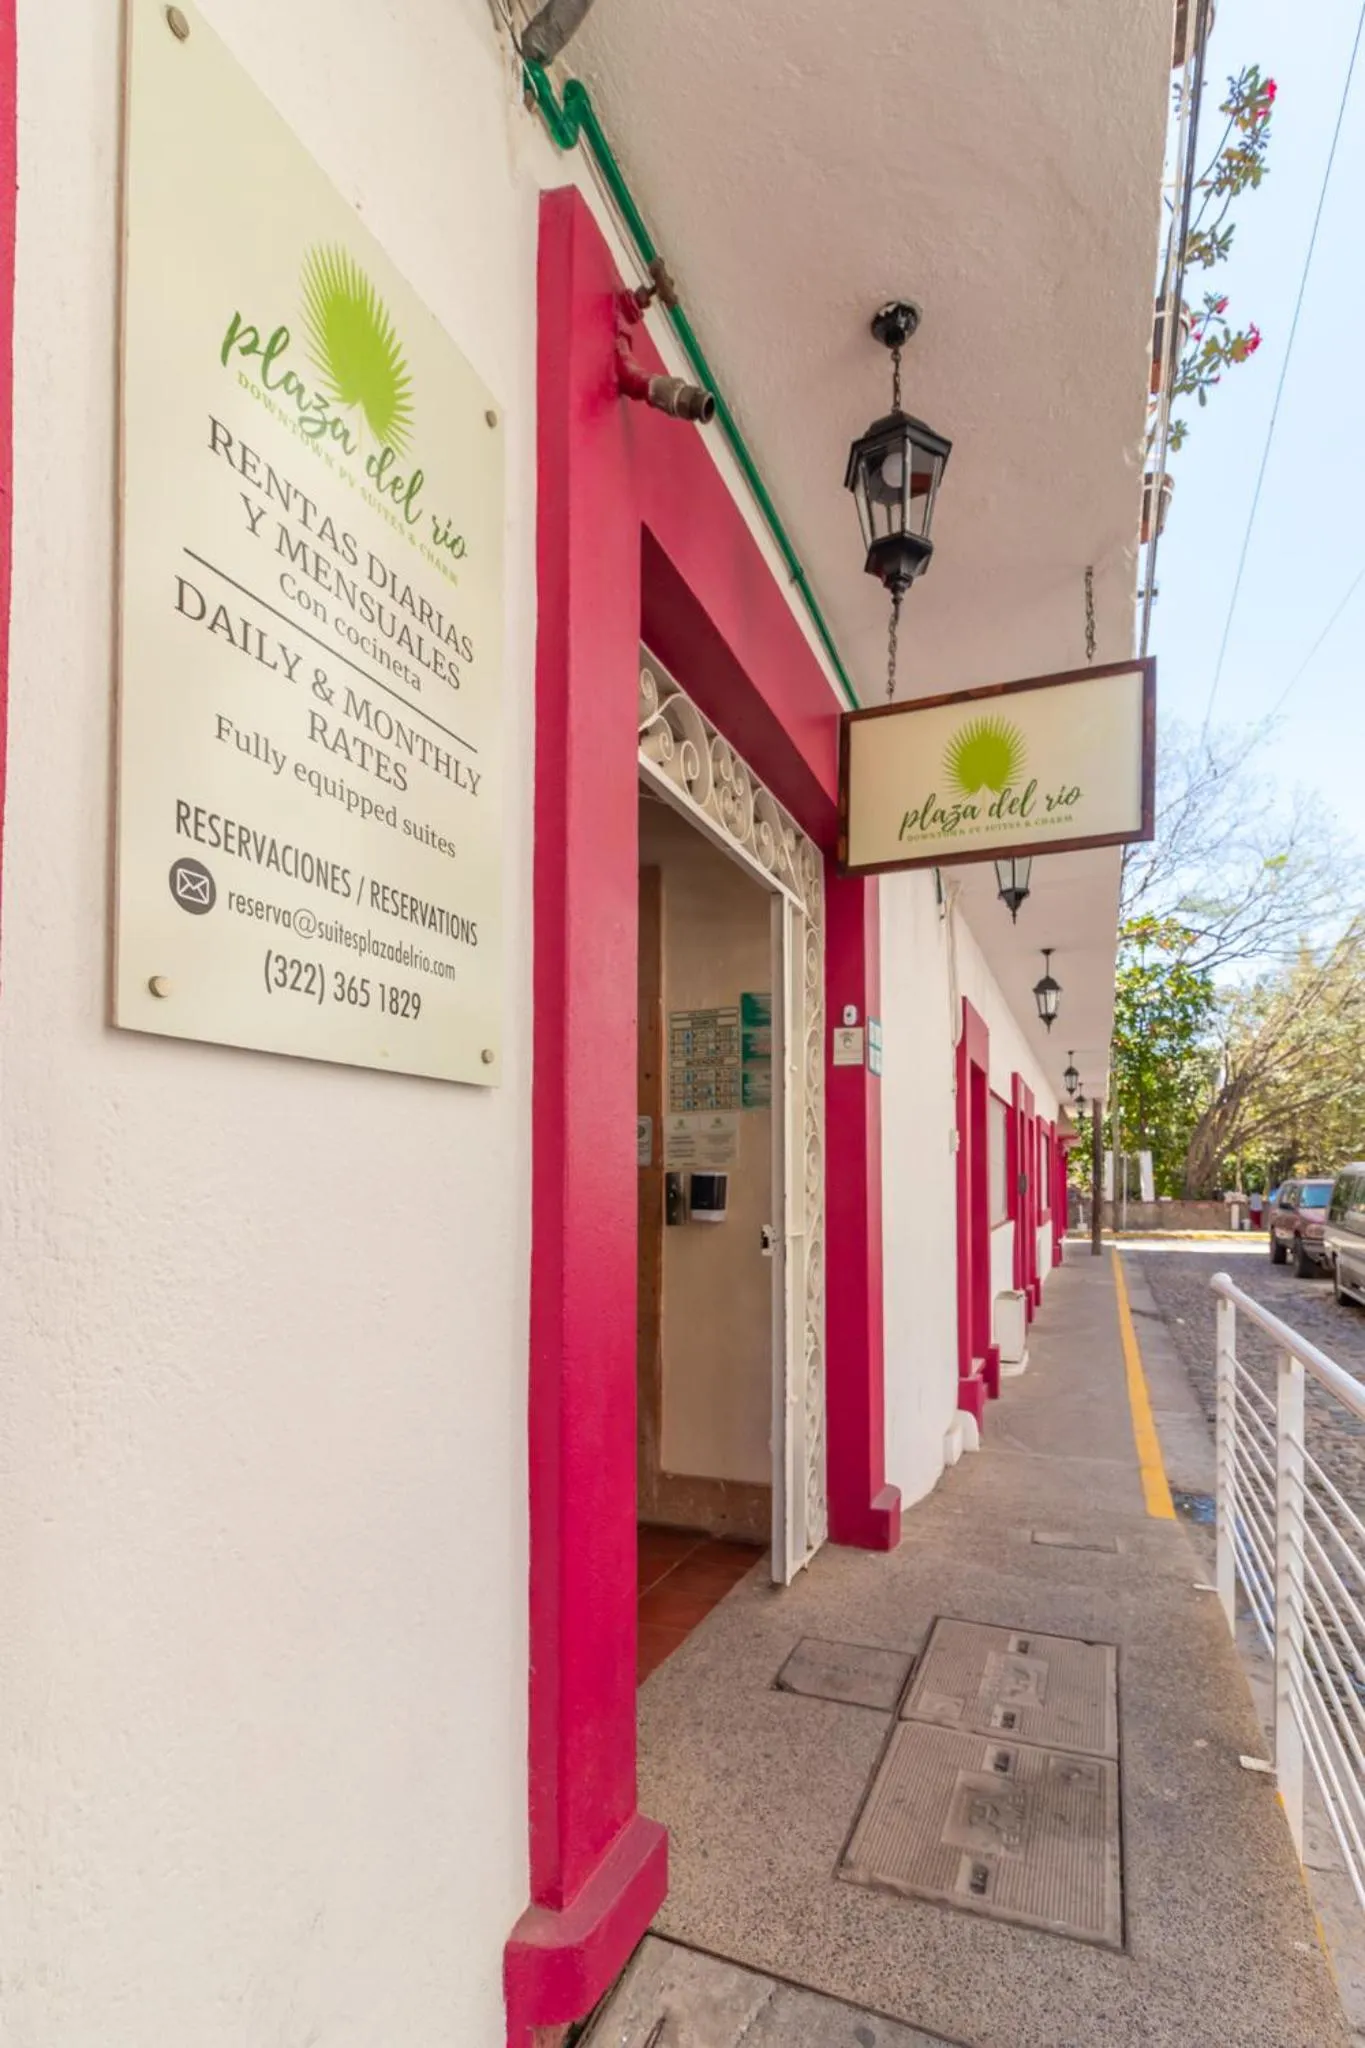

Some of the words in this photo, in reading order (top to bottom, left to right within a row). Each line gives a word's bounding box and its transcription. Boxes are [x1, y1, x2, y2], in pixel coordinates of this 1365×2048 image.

[220, 310, 357, 456] plaza
[365, 446, 424, 525] del
[236, 370, 334, 468] DOWNTOWN
[362, 485, 406, 536] SUITES
[207, 413, 358, 566] RENTAS
[367, 551, 474, 664] DIARIAS
[240, 491, 267, 538] Y
[275, 521, 460, 690] MENSUALES
[174, 574, 302, 684] DAILY
[311, 667, 336, 707] &
[342, 685, 482, 798] MONTHLY
[279, 572, 328, 625] Con
[334, 616, 422, 693] cocineta
[215, 713, 287, 776] Fully
[294, 761, 398, 829] equipped
[402, 818, 456, 859] suites
[307, 708, 408, 792] RATES
[898, 792, 982, 841] plaza
[988, 779, 1037, 819] del
[1034, 813, 1074, 826] CHARM
[176, 798, 352, 898] RESERVACIONES
[356, 875, 366, 907] /
[370, 880, 479, 948] RESERVATIONS
[228, 890, 456, 982] reserva@suitesplazadelrio.com
[264, 949, 326, 1005] (322)
[333, 971, 371, 1008] 365
[379, 983, 421, 1020] 1829
